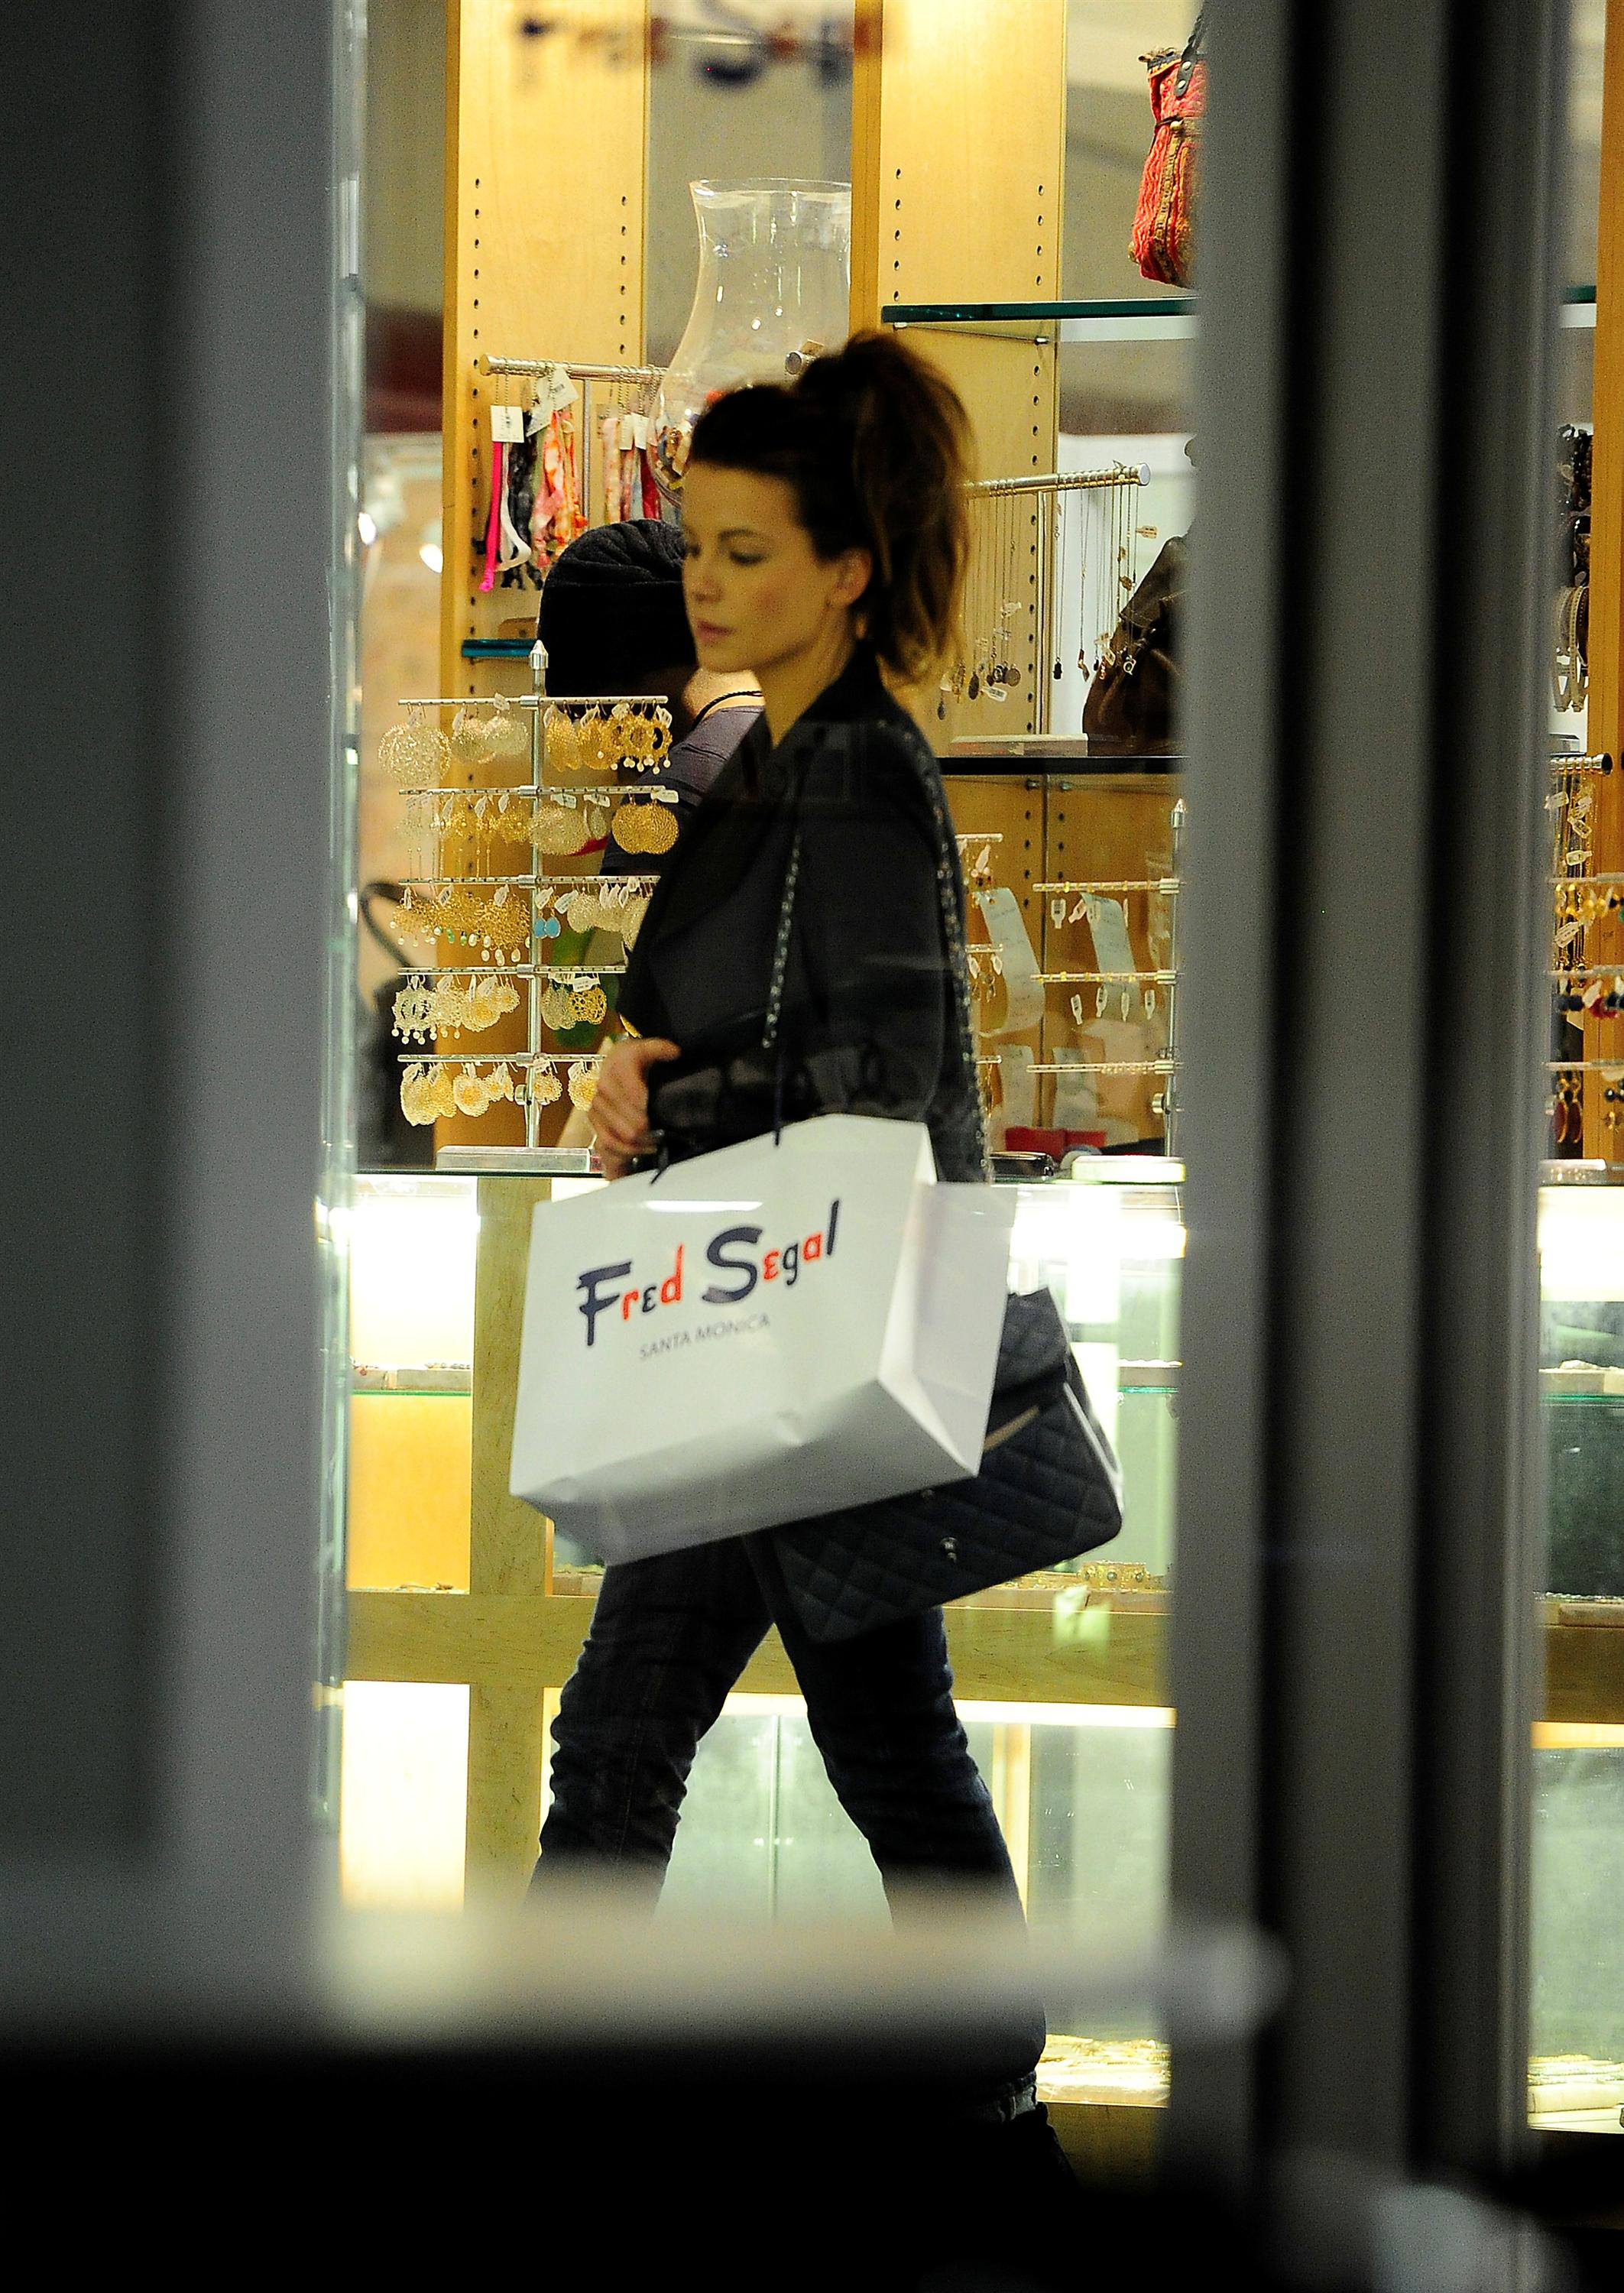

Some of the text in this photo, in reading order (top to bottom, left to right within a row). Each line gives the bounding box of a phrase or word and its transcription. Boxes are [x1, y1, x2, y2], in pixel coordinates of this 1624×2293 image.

[576, 1199, 840, 1346] Fred Segal
[640, 1312, 770, 1361] SANTA MONICA
